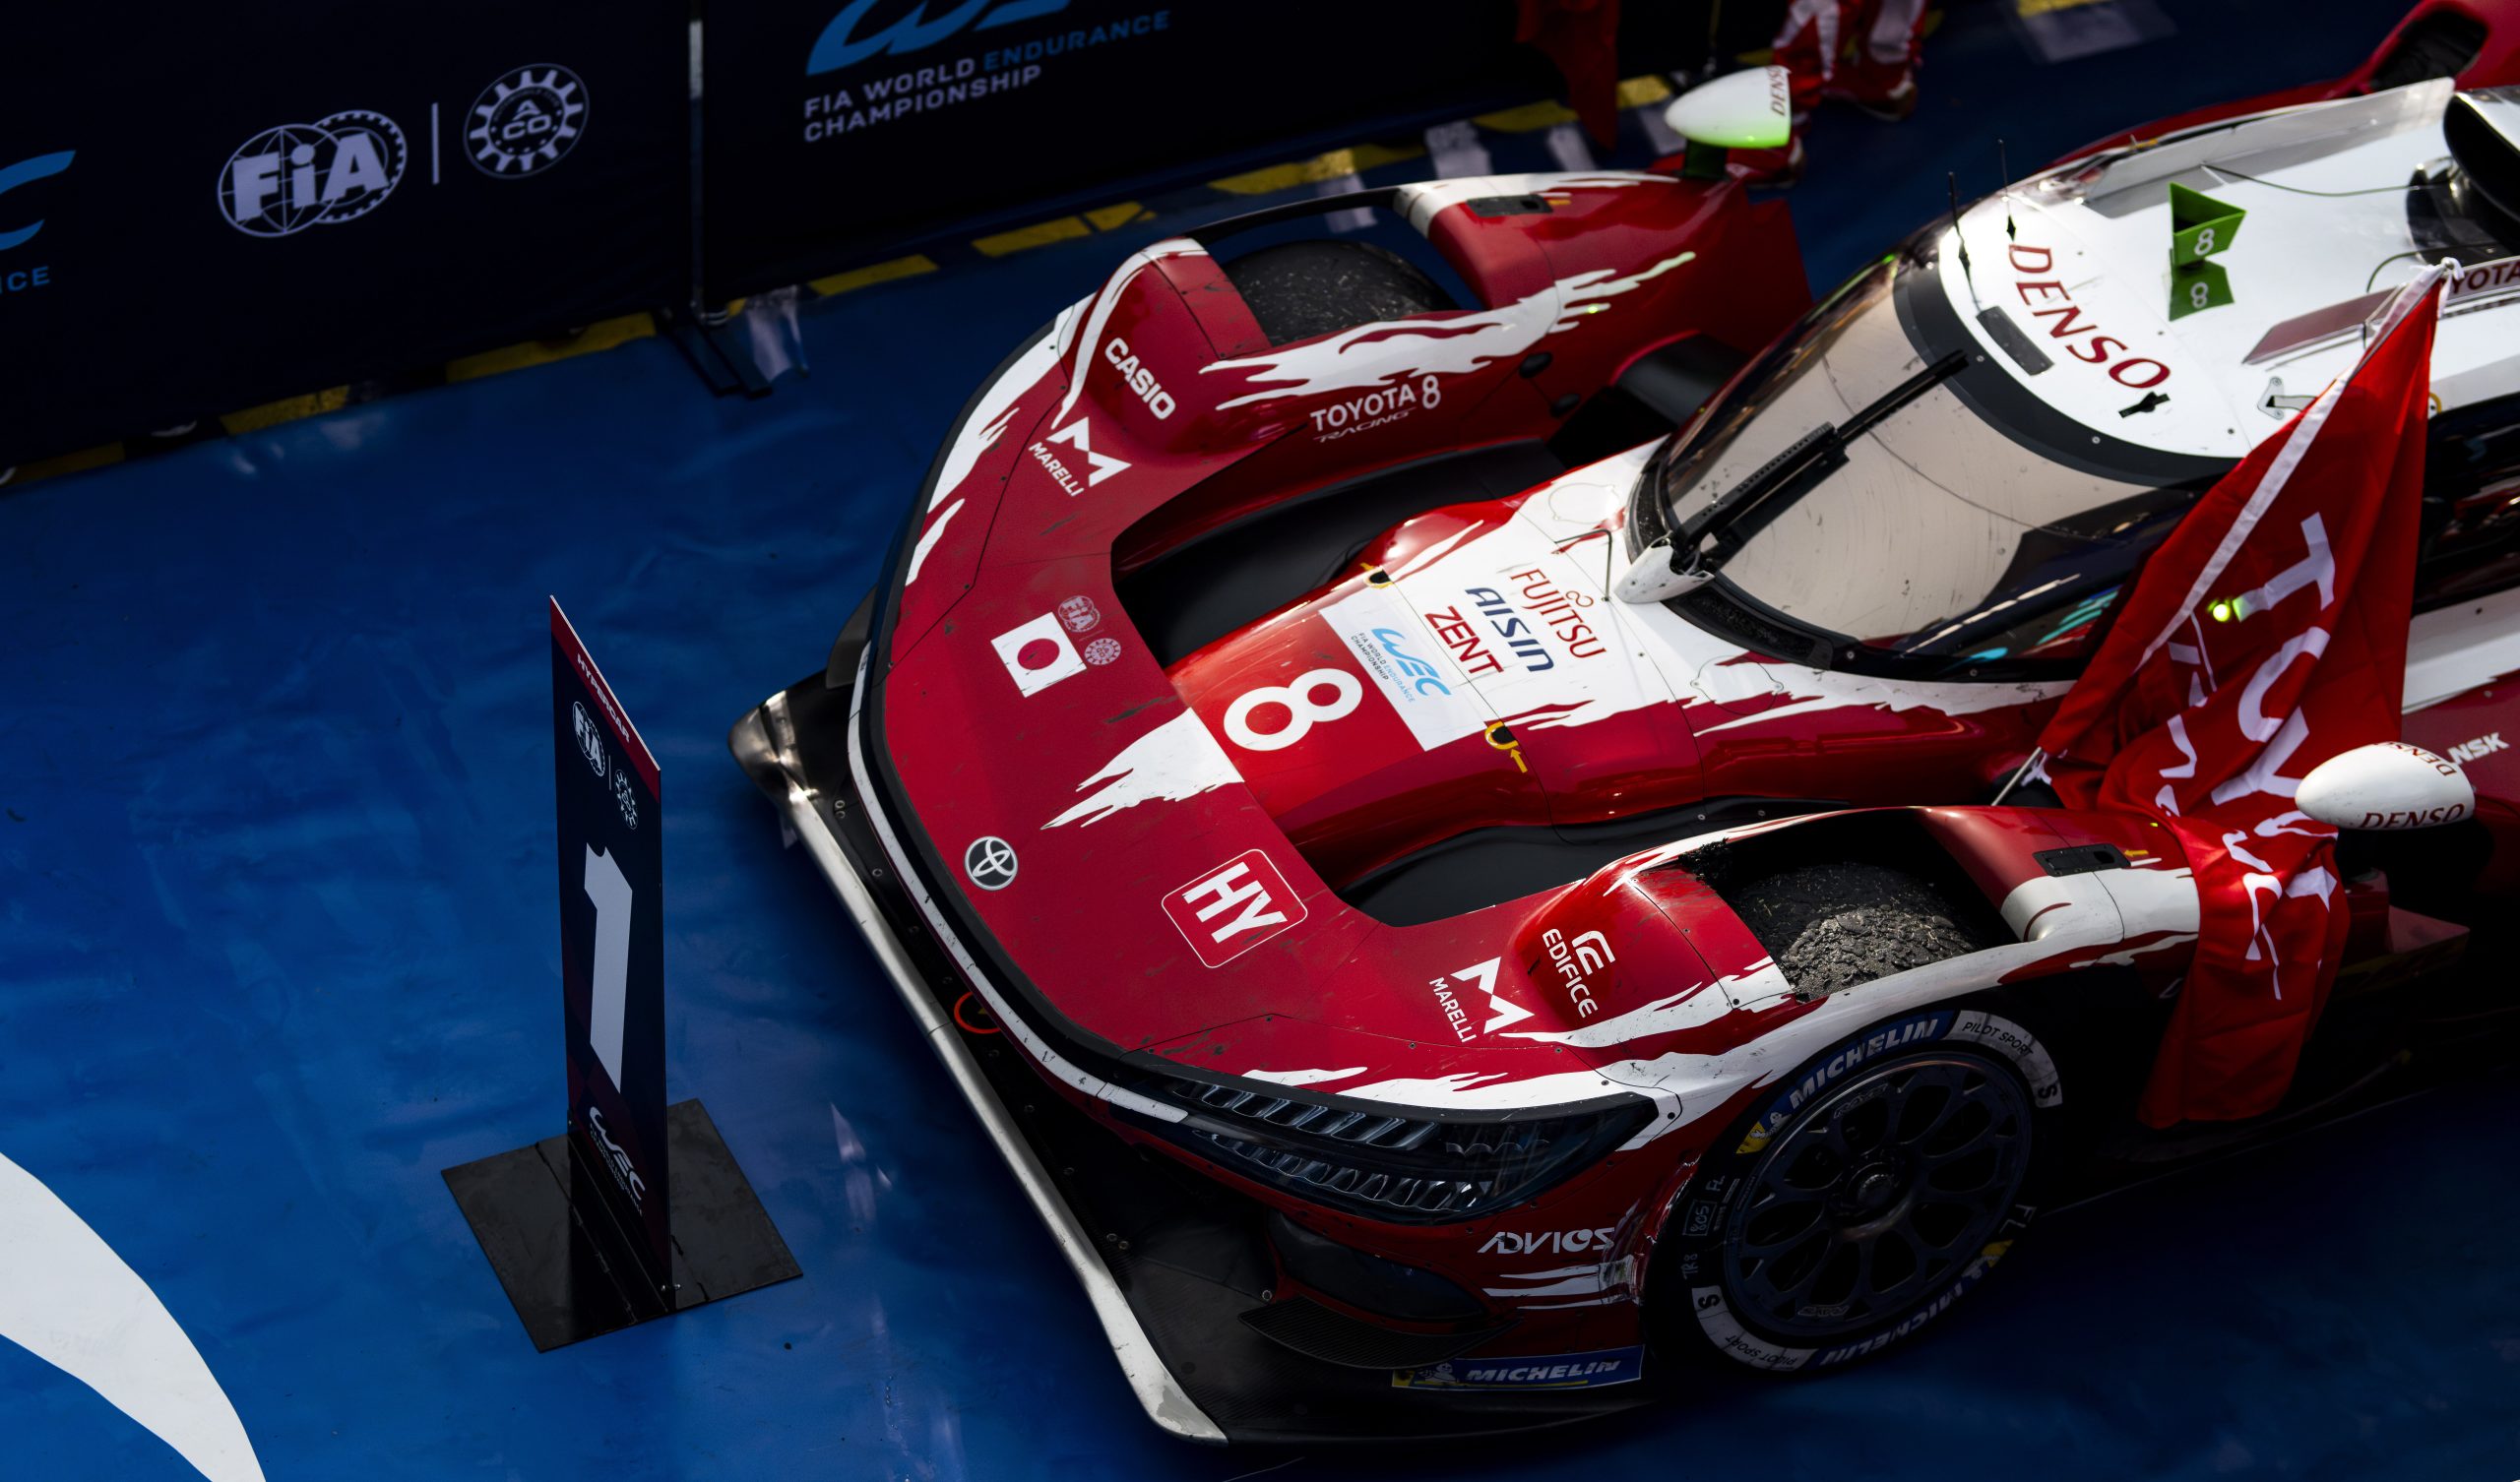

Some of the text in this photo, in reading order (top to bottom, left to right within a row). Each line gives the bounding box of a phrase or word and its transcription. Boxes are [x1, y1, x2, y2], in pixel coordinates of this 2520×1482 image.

[804, 90, 854, 120] FIA
[862, 57, 976, 102] WORLD
[981, 10, 1173, 73] ENDURANCE
[803, 64, 1043, 144] CHAMPIONSHIP
[2194, 227, 2216, 258] 8
[2008, 243, 2172, 390] DENSO
[1103, 337, 1177, 421] CASIO
[1309, 374, 1442, 433] TOYOTA 8
[1313, 406, 1418, 443] RACING
[1028, 441, 1085, 498] MARELLI
[1423, 605, 1505, 676] ZENT
[1463, 587, 1555, 674] AISIN
[1509, 568, 1607, 659] FUJITSU
[1351, 634, 1390, 681] CHAMPIONSHIP
[1358, 631, 1417, 704] FIA WORLD ENDURANCE
[1370, 628, 1453, 697] WEC
[576, 652, 631, 744] HYPERCAR
[1223, 667, 1364, 753] 8
[2446, 731, 2510, 767] NSK
[2360, 803, 2466, 830] DENSO
[1181, 860, 1289, 945] HY
[584, 842, 633, 1095] 1
[1541, 927, 1599, 1020] EDIFICE
[1427, 976, 1479, 1043] MARELLI
[1961, 1020, 2035, 1058] PILOT SPORT
[1788, 1018, 1939, 1109] MICHELIN
[2038, 1083, 2057, 1099] S
[1698, 1292, 1721, 1310] S
[1465, 1359, 1622, 1382] MICHELIN
[1725, 1333, 1798, 1366] PILOT SPORT
